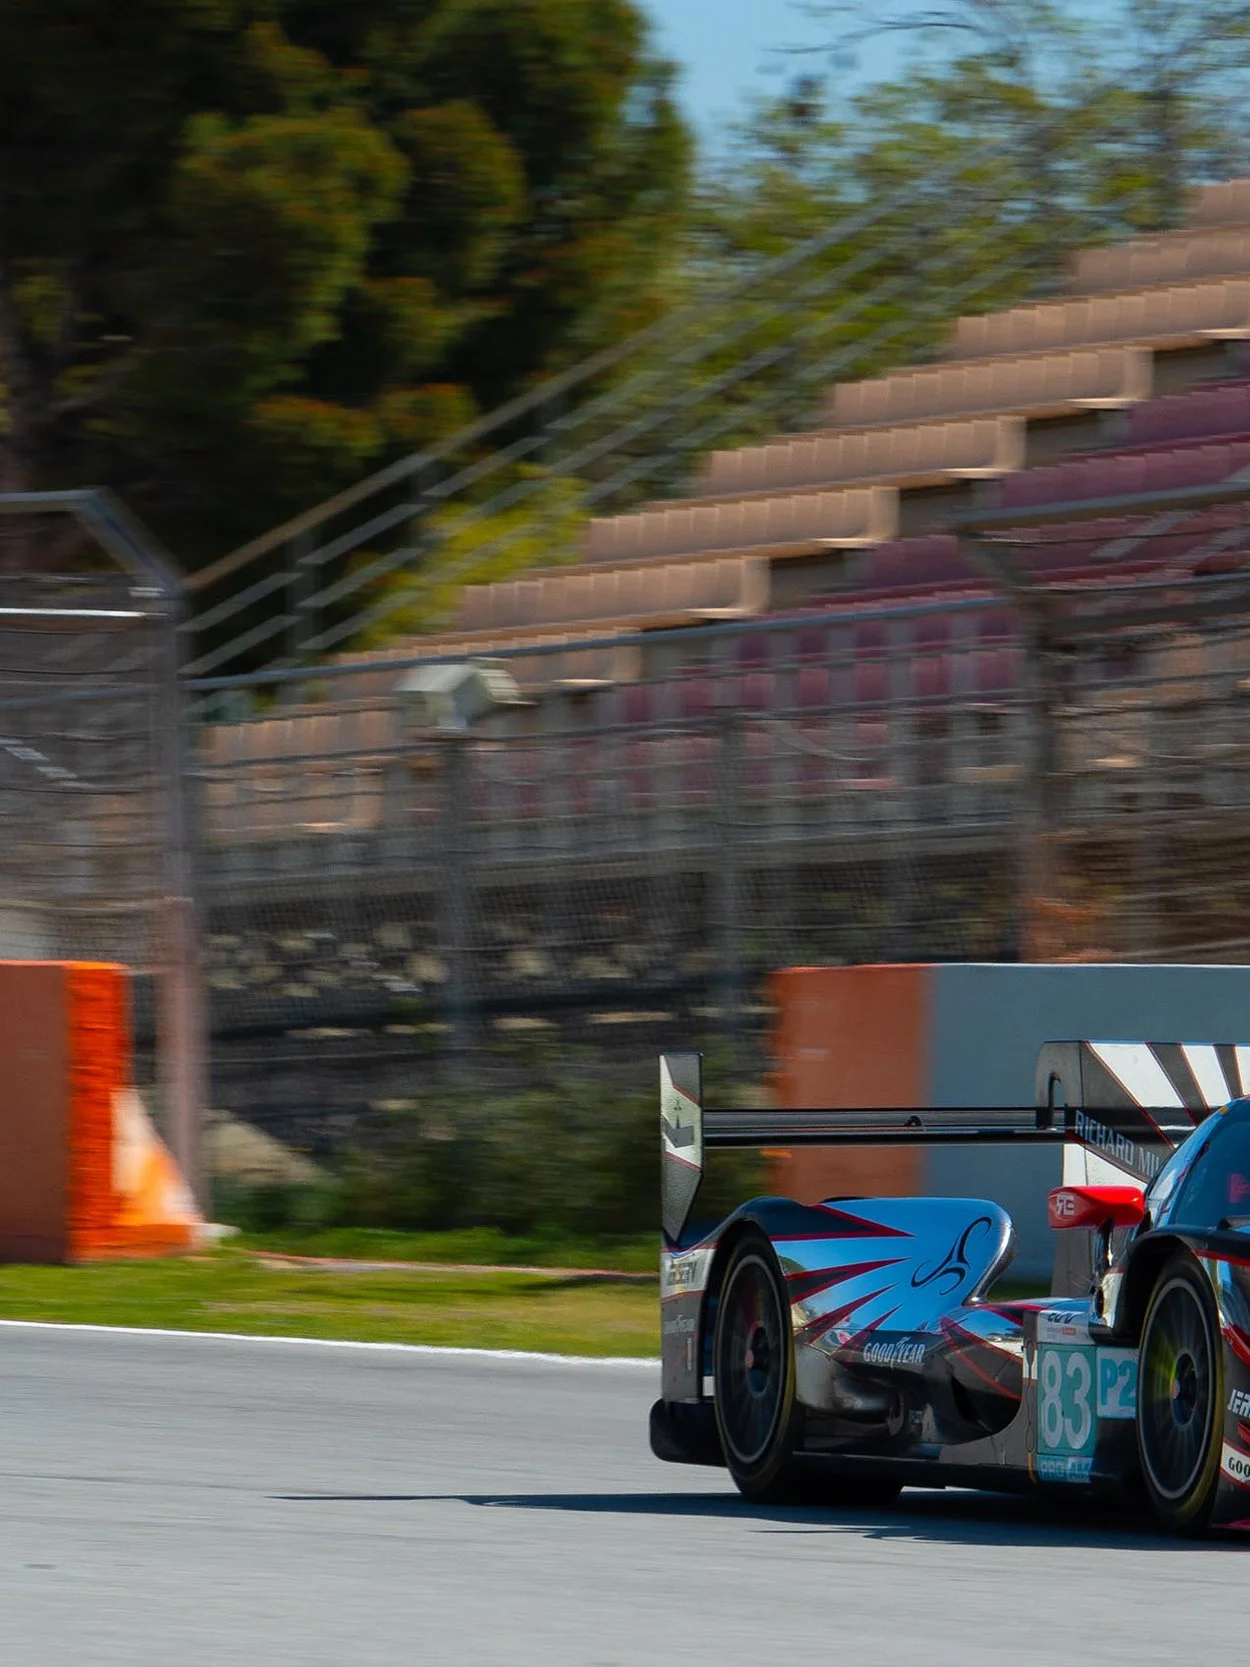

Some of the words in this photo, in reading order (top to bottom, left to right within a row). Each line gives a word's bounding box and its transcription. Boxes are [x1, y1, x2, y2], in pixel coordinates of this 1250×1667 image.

[1075, 1109, 1135, 1167] RICHARD
[862, 1338, 926, 1365] GOODYEAR
[1041, 1351, 1091, 1449] 83
[1100, 1359, 1137, 1407] P2
